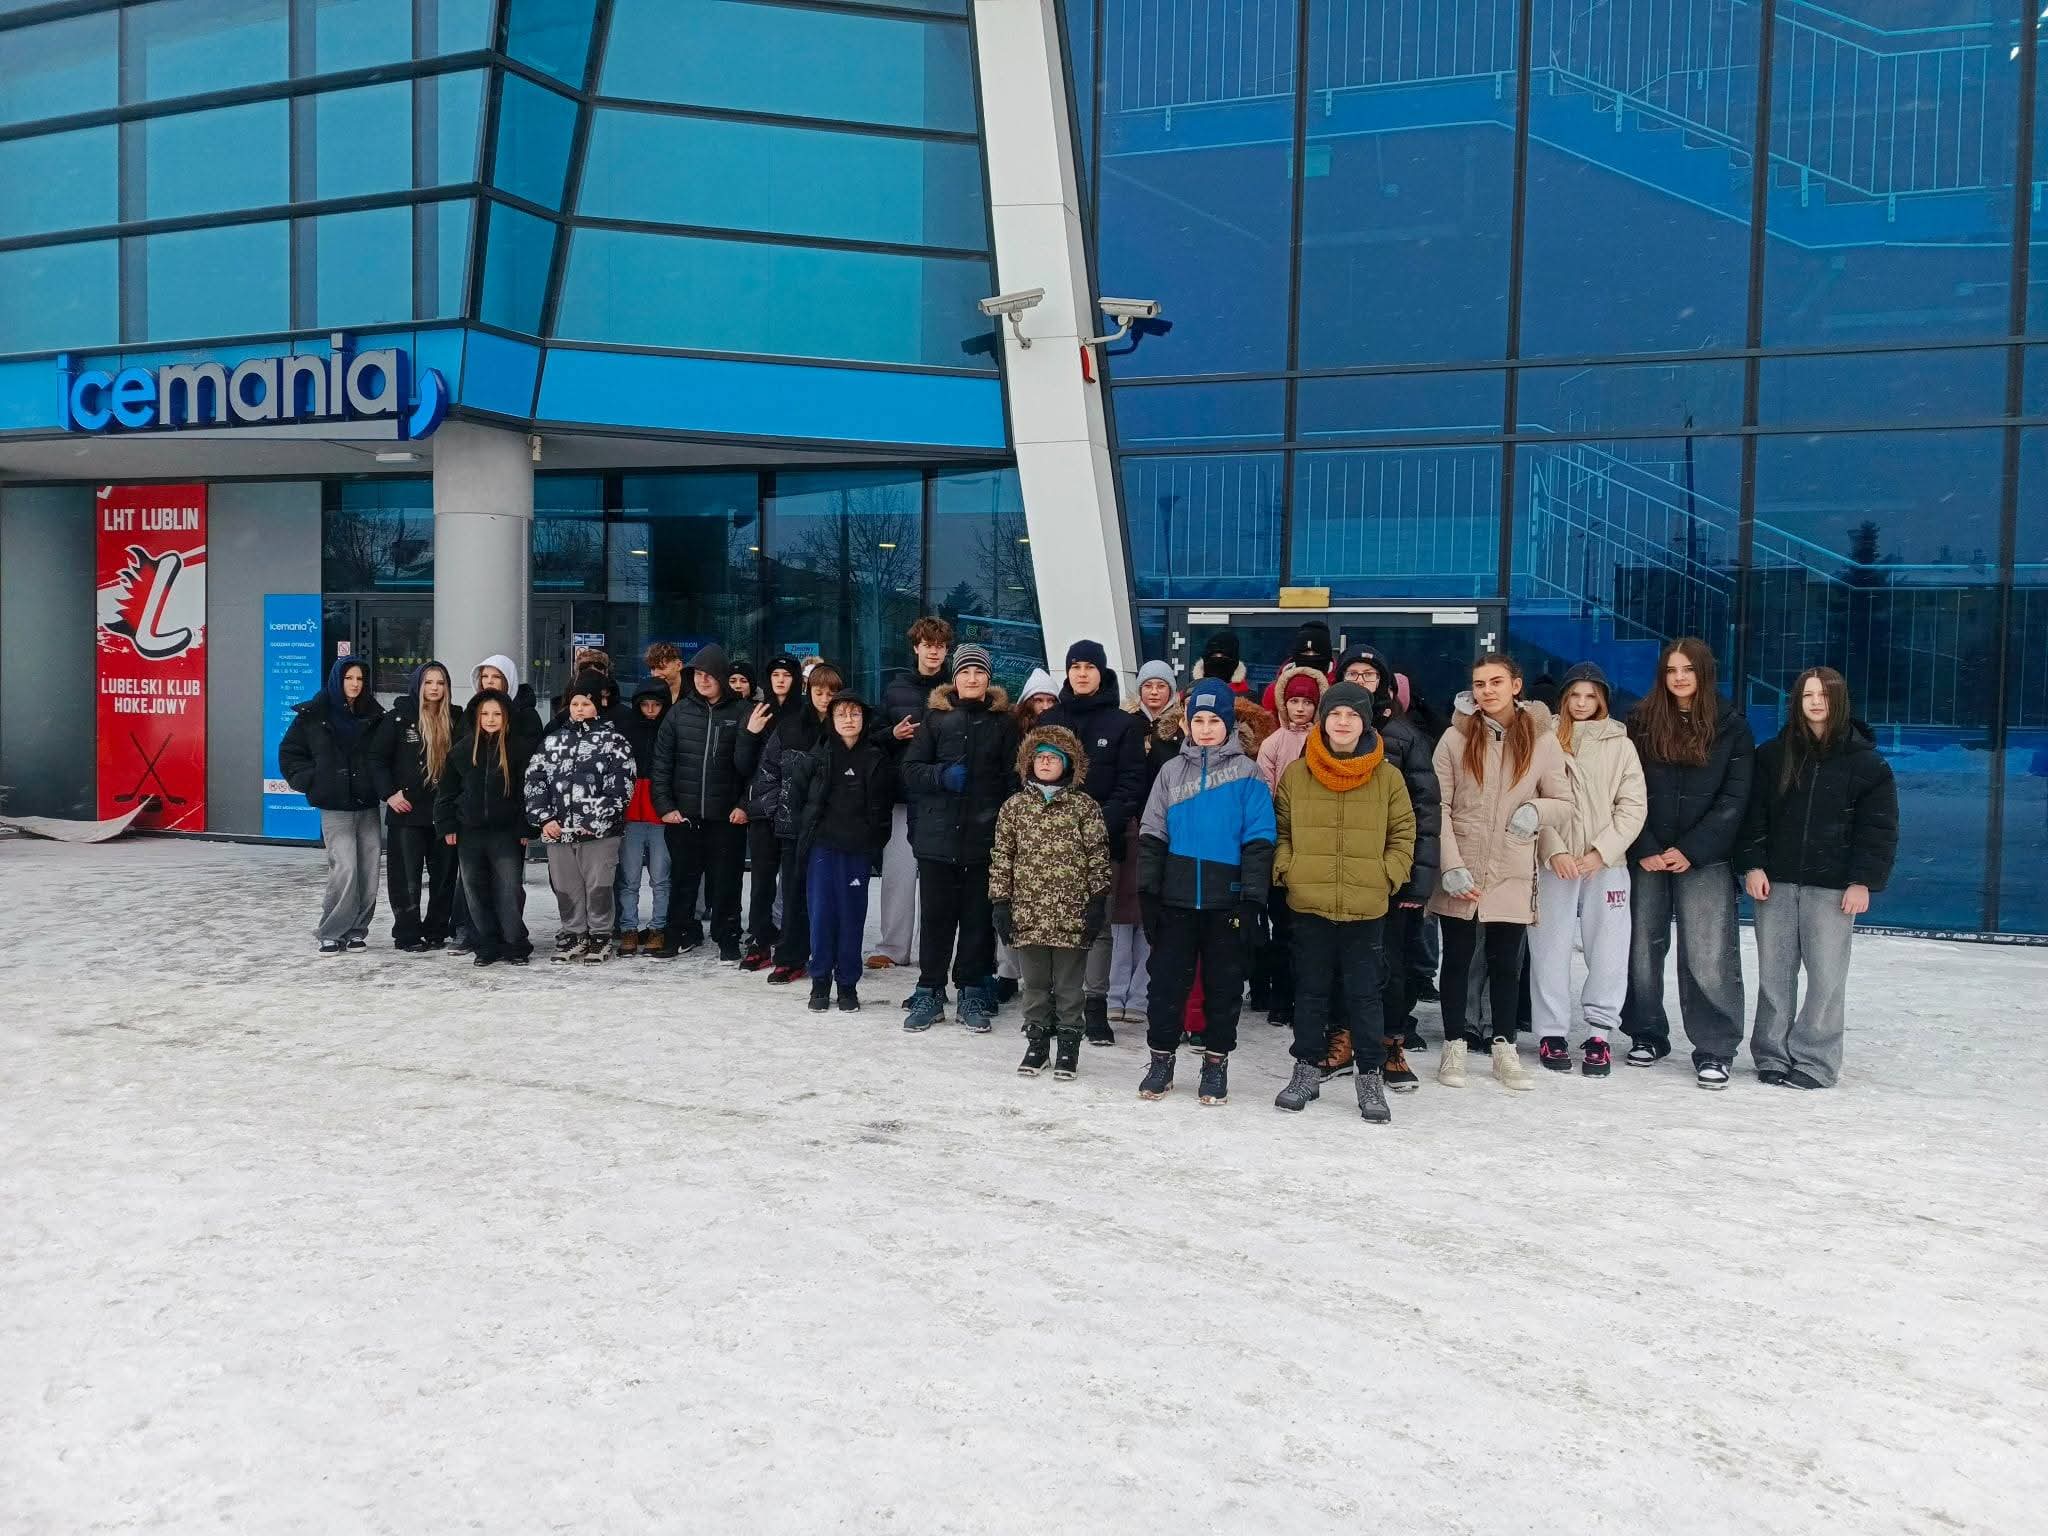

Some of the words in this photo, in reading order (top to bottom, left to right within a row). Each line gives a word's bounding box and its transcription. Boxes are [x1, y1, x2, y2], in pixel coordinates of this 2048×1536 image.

[56, 333, 407, 433] icemania
[104, 508, 135, 531] LHT
[141, 507, 199, 531] LUBLIN
[269, 620, 307, 631] icemania
[101, 678, 162, 695] LUBELSKI
[166, 679, 201, 696] KLUB
[114, 696, 187, 715] HOKEJOWY
[1606, 890, 1626, 903] NYC
